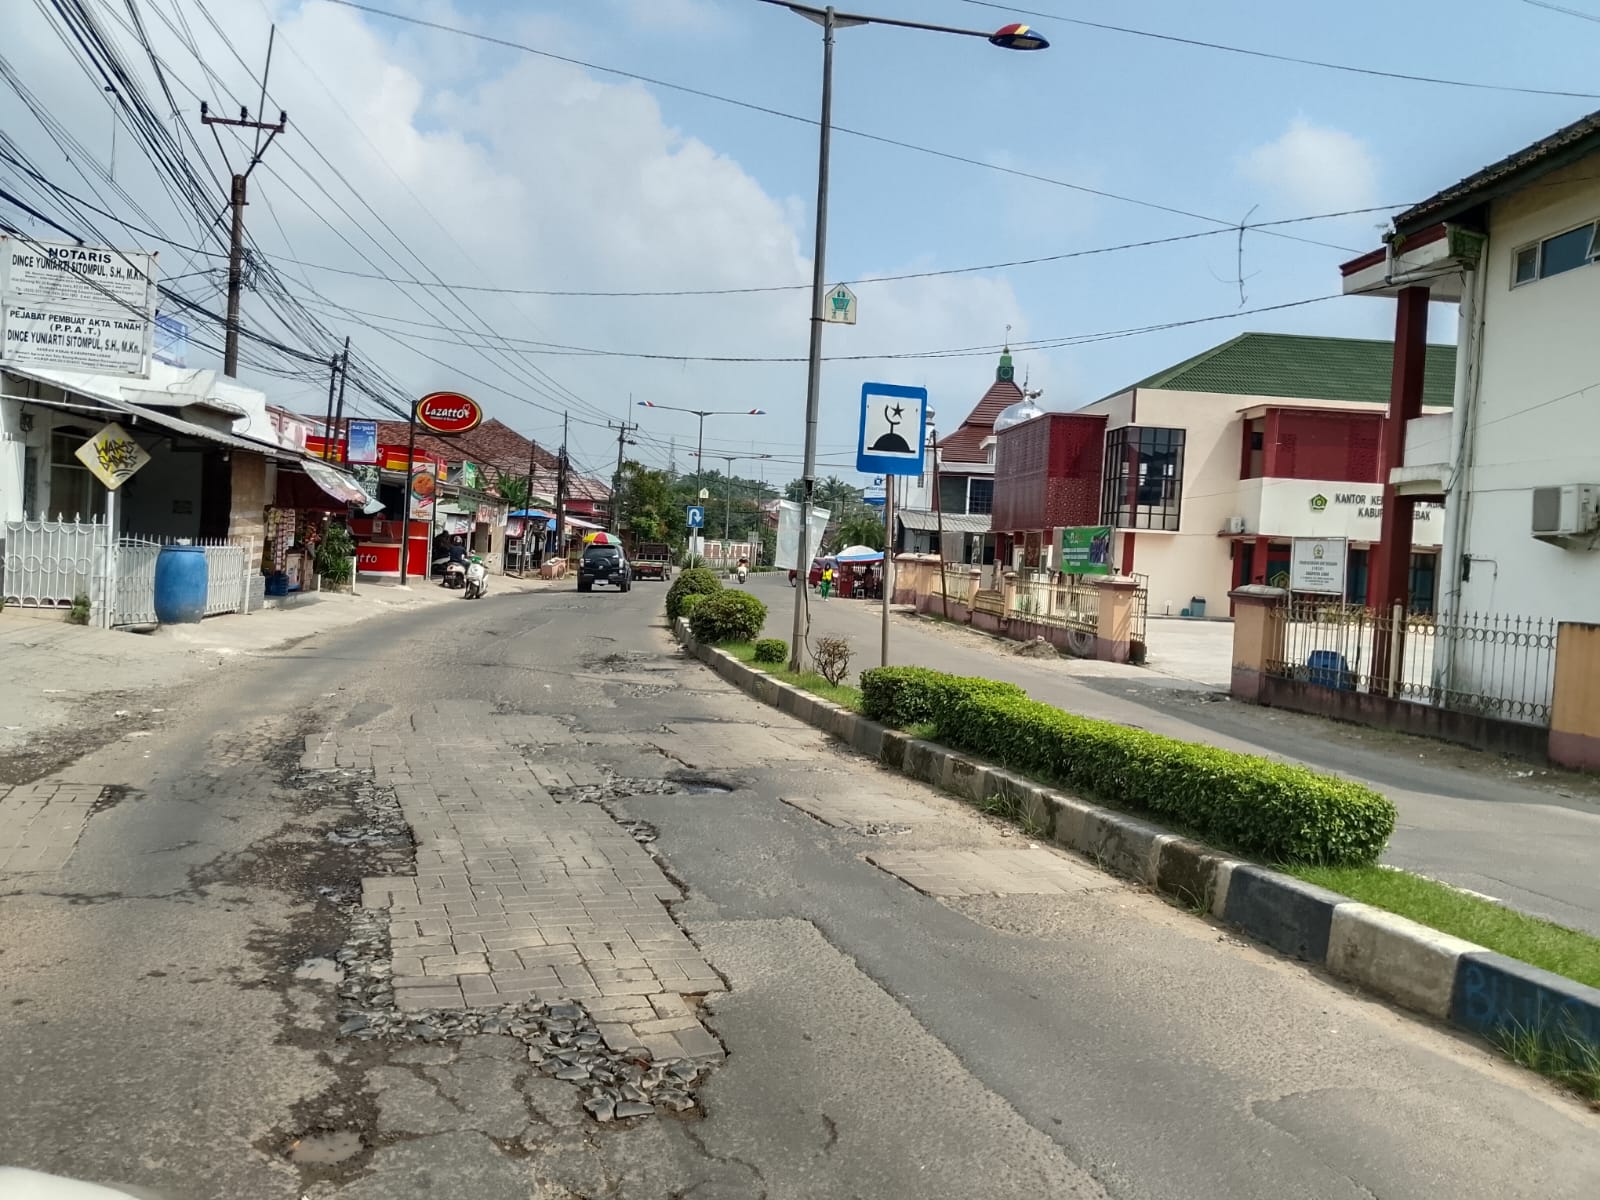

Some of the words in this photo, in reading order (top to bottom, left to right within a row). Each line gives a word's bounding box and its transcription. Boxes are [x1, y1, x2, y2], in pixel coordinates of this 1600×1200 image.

[12, 254, 34, 268] DINCE
[48, 247, 112, 264] NOTARIS
[10, 310, 47, 321] PEJABAT
[48, 314, 86, 325] PEMBUAT
[88, 318, 111, 328] AKTA
[114, 321, 141, 331] TANAH
[7, 329, 29, 343] DINCE
[31, 331, 65, 346] YUNIARTI
[424, 402, 465, 419] Lazatto
[1335, 493, 1366, 505] KANTOR
